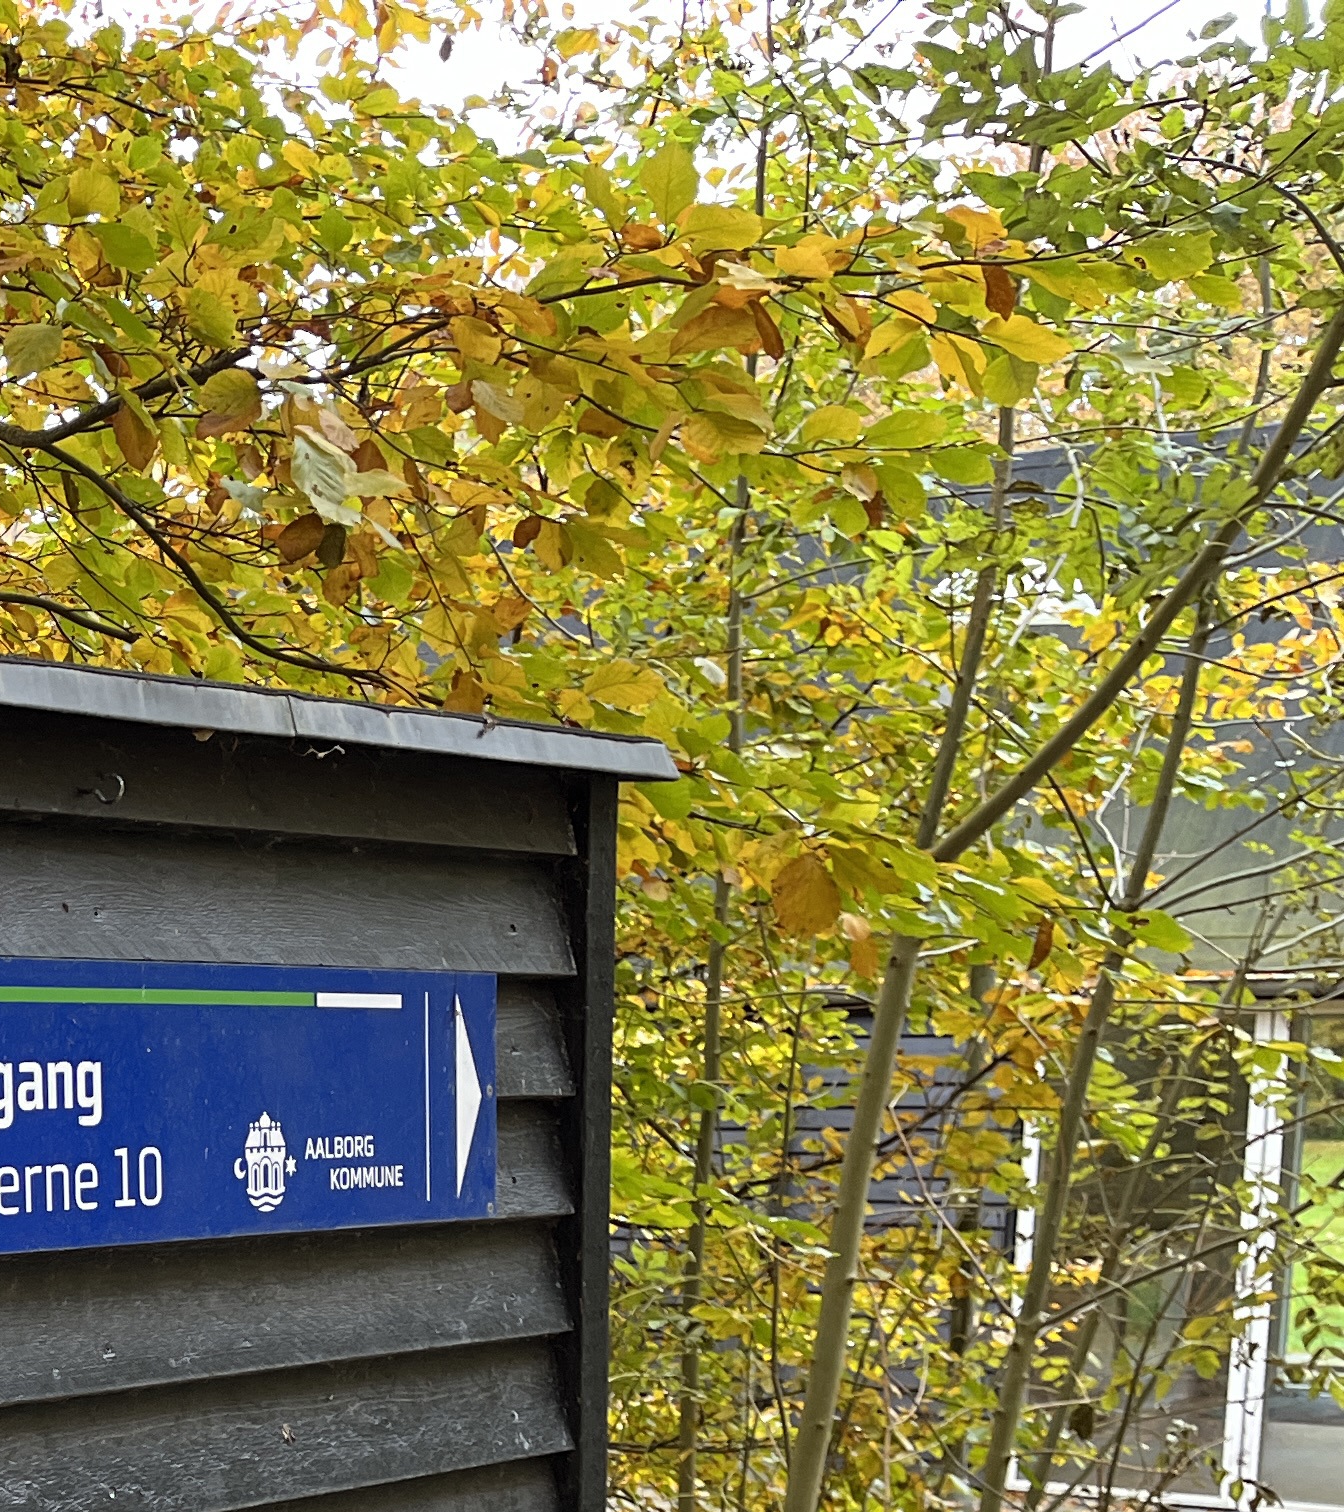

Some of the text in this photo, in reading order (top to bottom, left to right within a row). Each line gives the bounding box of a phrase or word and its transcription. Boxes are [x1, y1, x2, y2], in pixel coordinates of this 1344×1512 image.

[304, 1134, 375, 1161] AALBORG
[113, 1145, 164, 1209] 10
[329, 1164, 405, 1191] KOMMUNE
